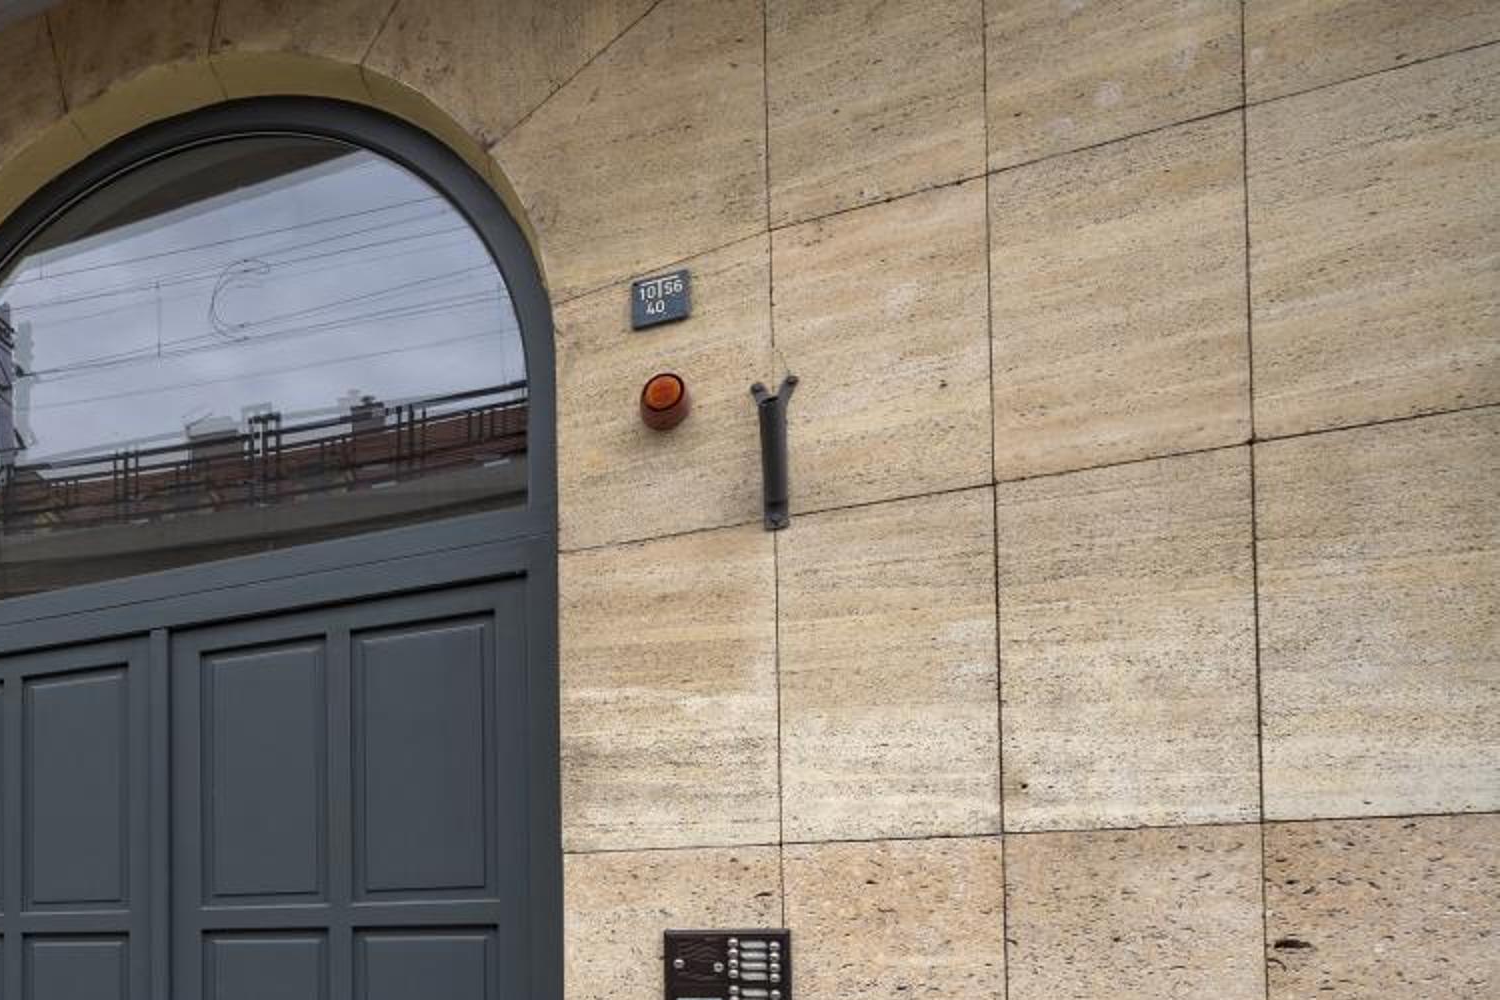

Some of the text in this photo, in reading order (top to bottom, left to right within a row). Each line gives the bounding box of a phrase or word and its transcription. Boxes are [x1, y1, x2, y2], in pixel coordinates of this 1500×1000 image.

[640, 280, 683, 300] 10 56
[646, 300, 665, 315] 40
